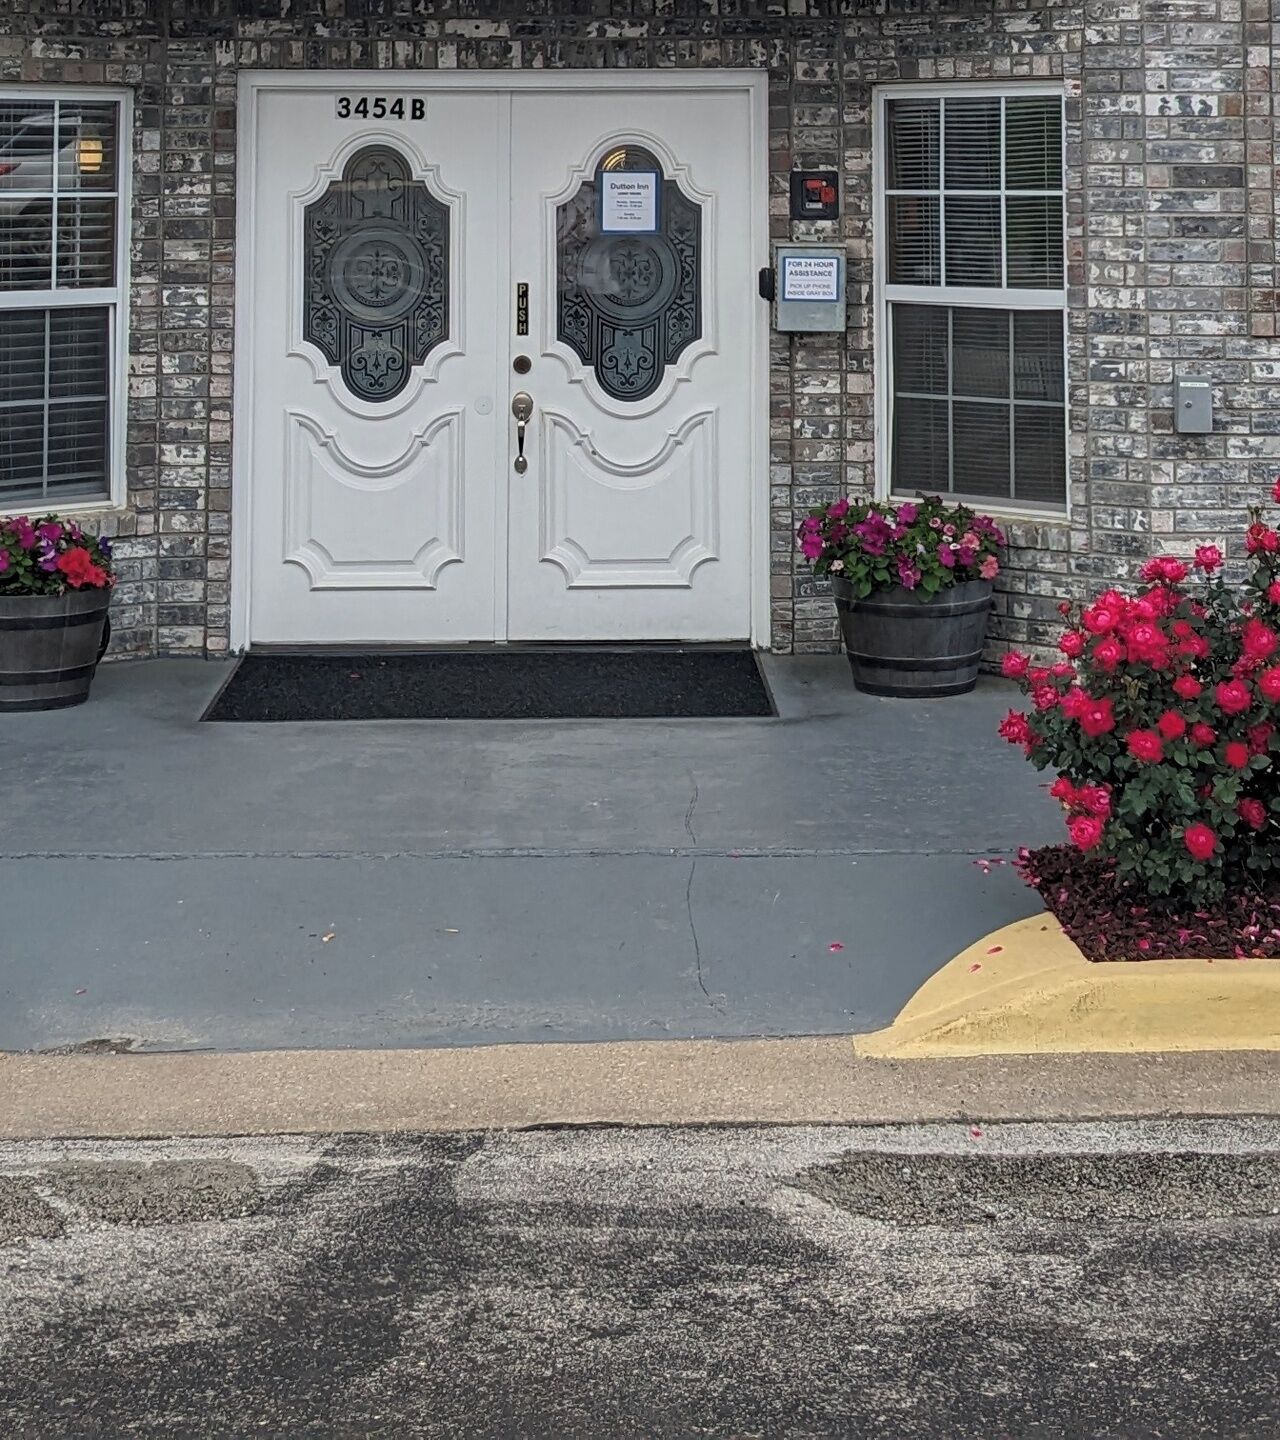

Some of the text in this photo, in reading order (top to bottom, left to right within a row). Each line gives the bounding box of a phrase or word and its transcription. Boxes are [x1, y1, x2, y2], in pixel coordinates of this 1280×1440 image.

[610, 182, 649, 190] Dutton Inn
[518, 284, 527, 334] PUSH
